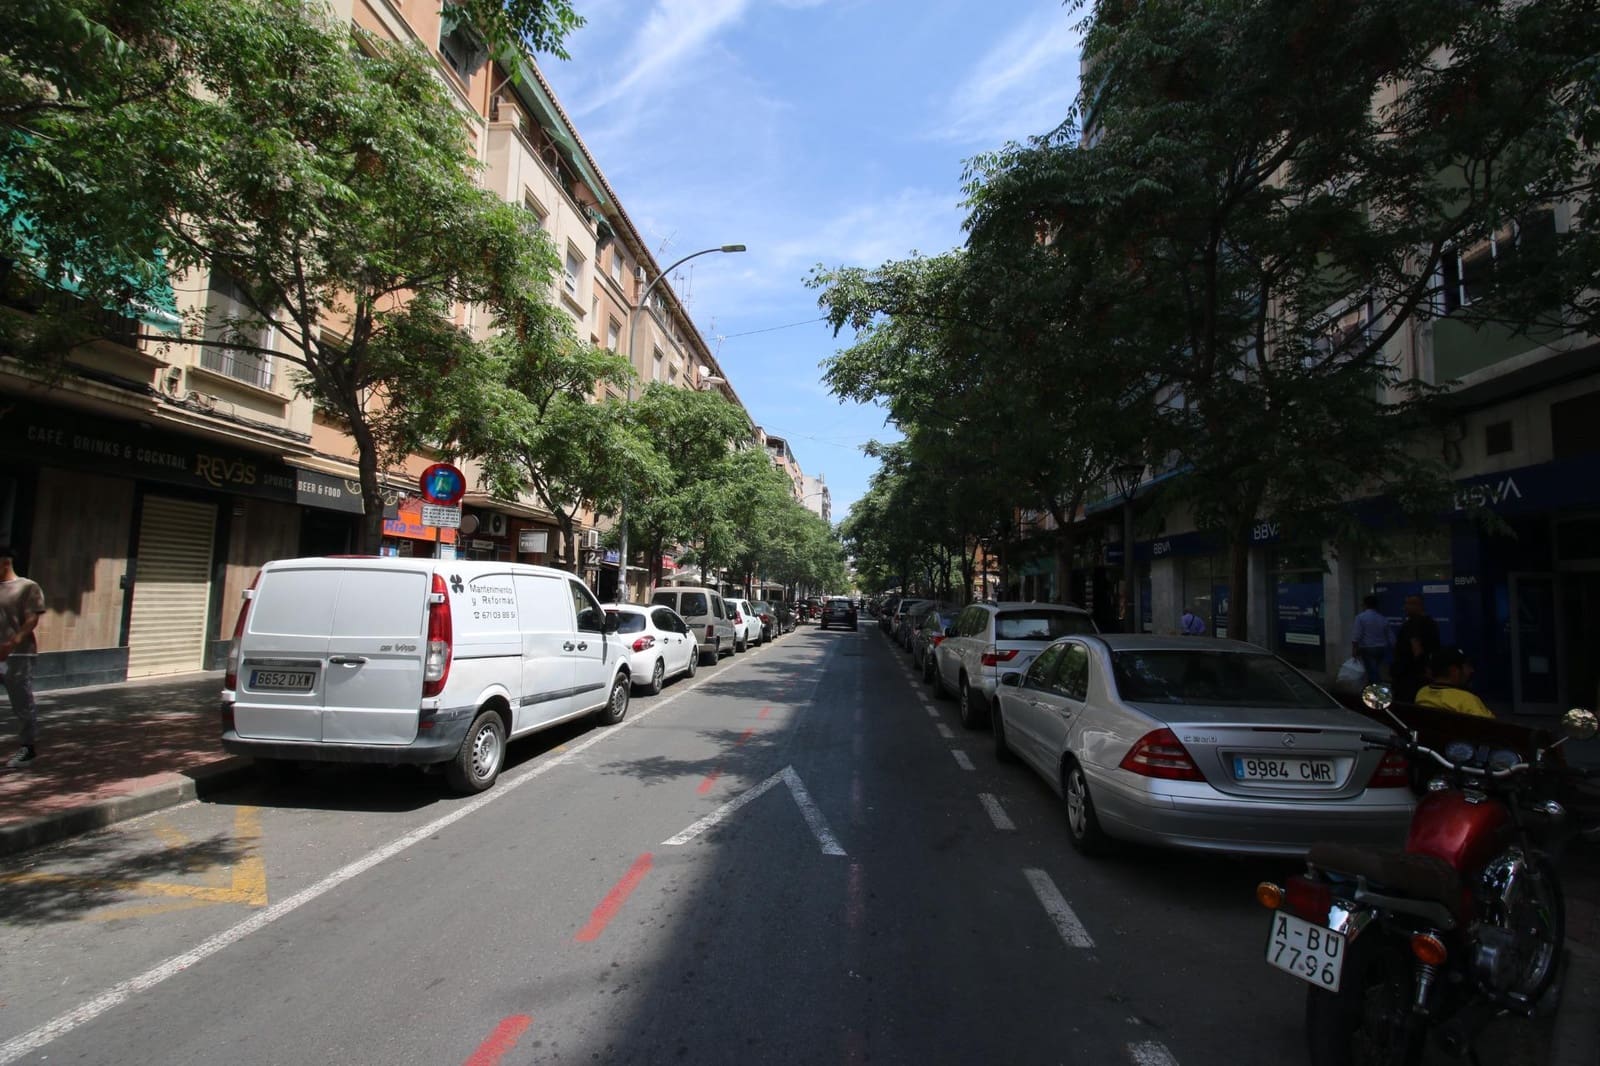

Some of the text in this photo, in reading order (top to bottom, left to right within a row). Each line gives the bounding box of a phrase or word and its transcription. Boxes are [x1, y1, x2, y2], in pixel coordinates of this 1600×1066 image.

[73, 434, 120, 456] DRINKS
[124, 444, 132, 459] &
[137, 448, 188, 470] COCKTAIL
[298, 480, 316, 493] BEER
[318, 483, 323, 495] &
[324, 485, 341, 498] FOOD
[482, 595, 514, 605] Reformas
[258, 673, 286, 686] 6652
[1247, 760, 1331, 780] 9984 CMR
[1276, 916, 1339, 958] A-BU
[1275, 940, 1334, 985] 7796
